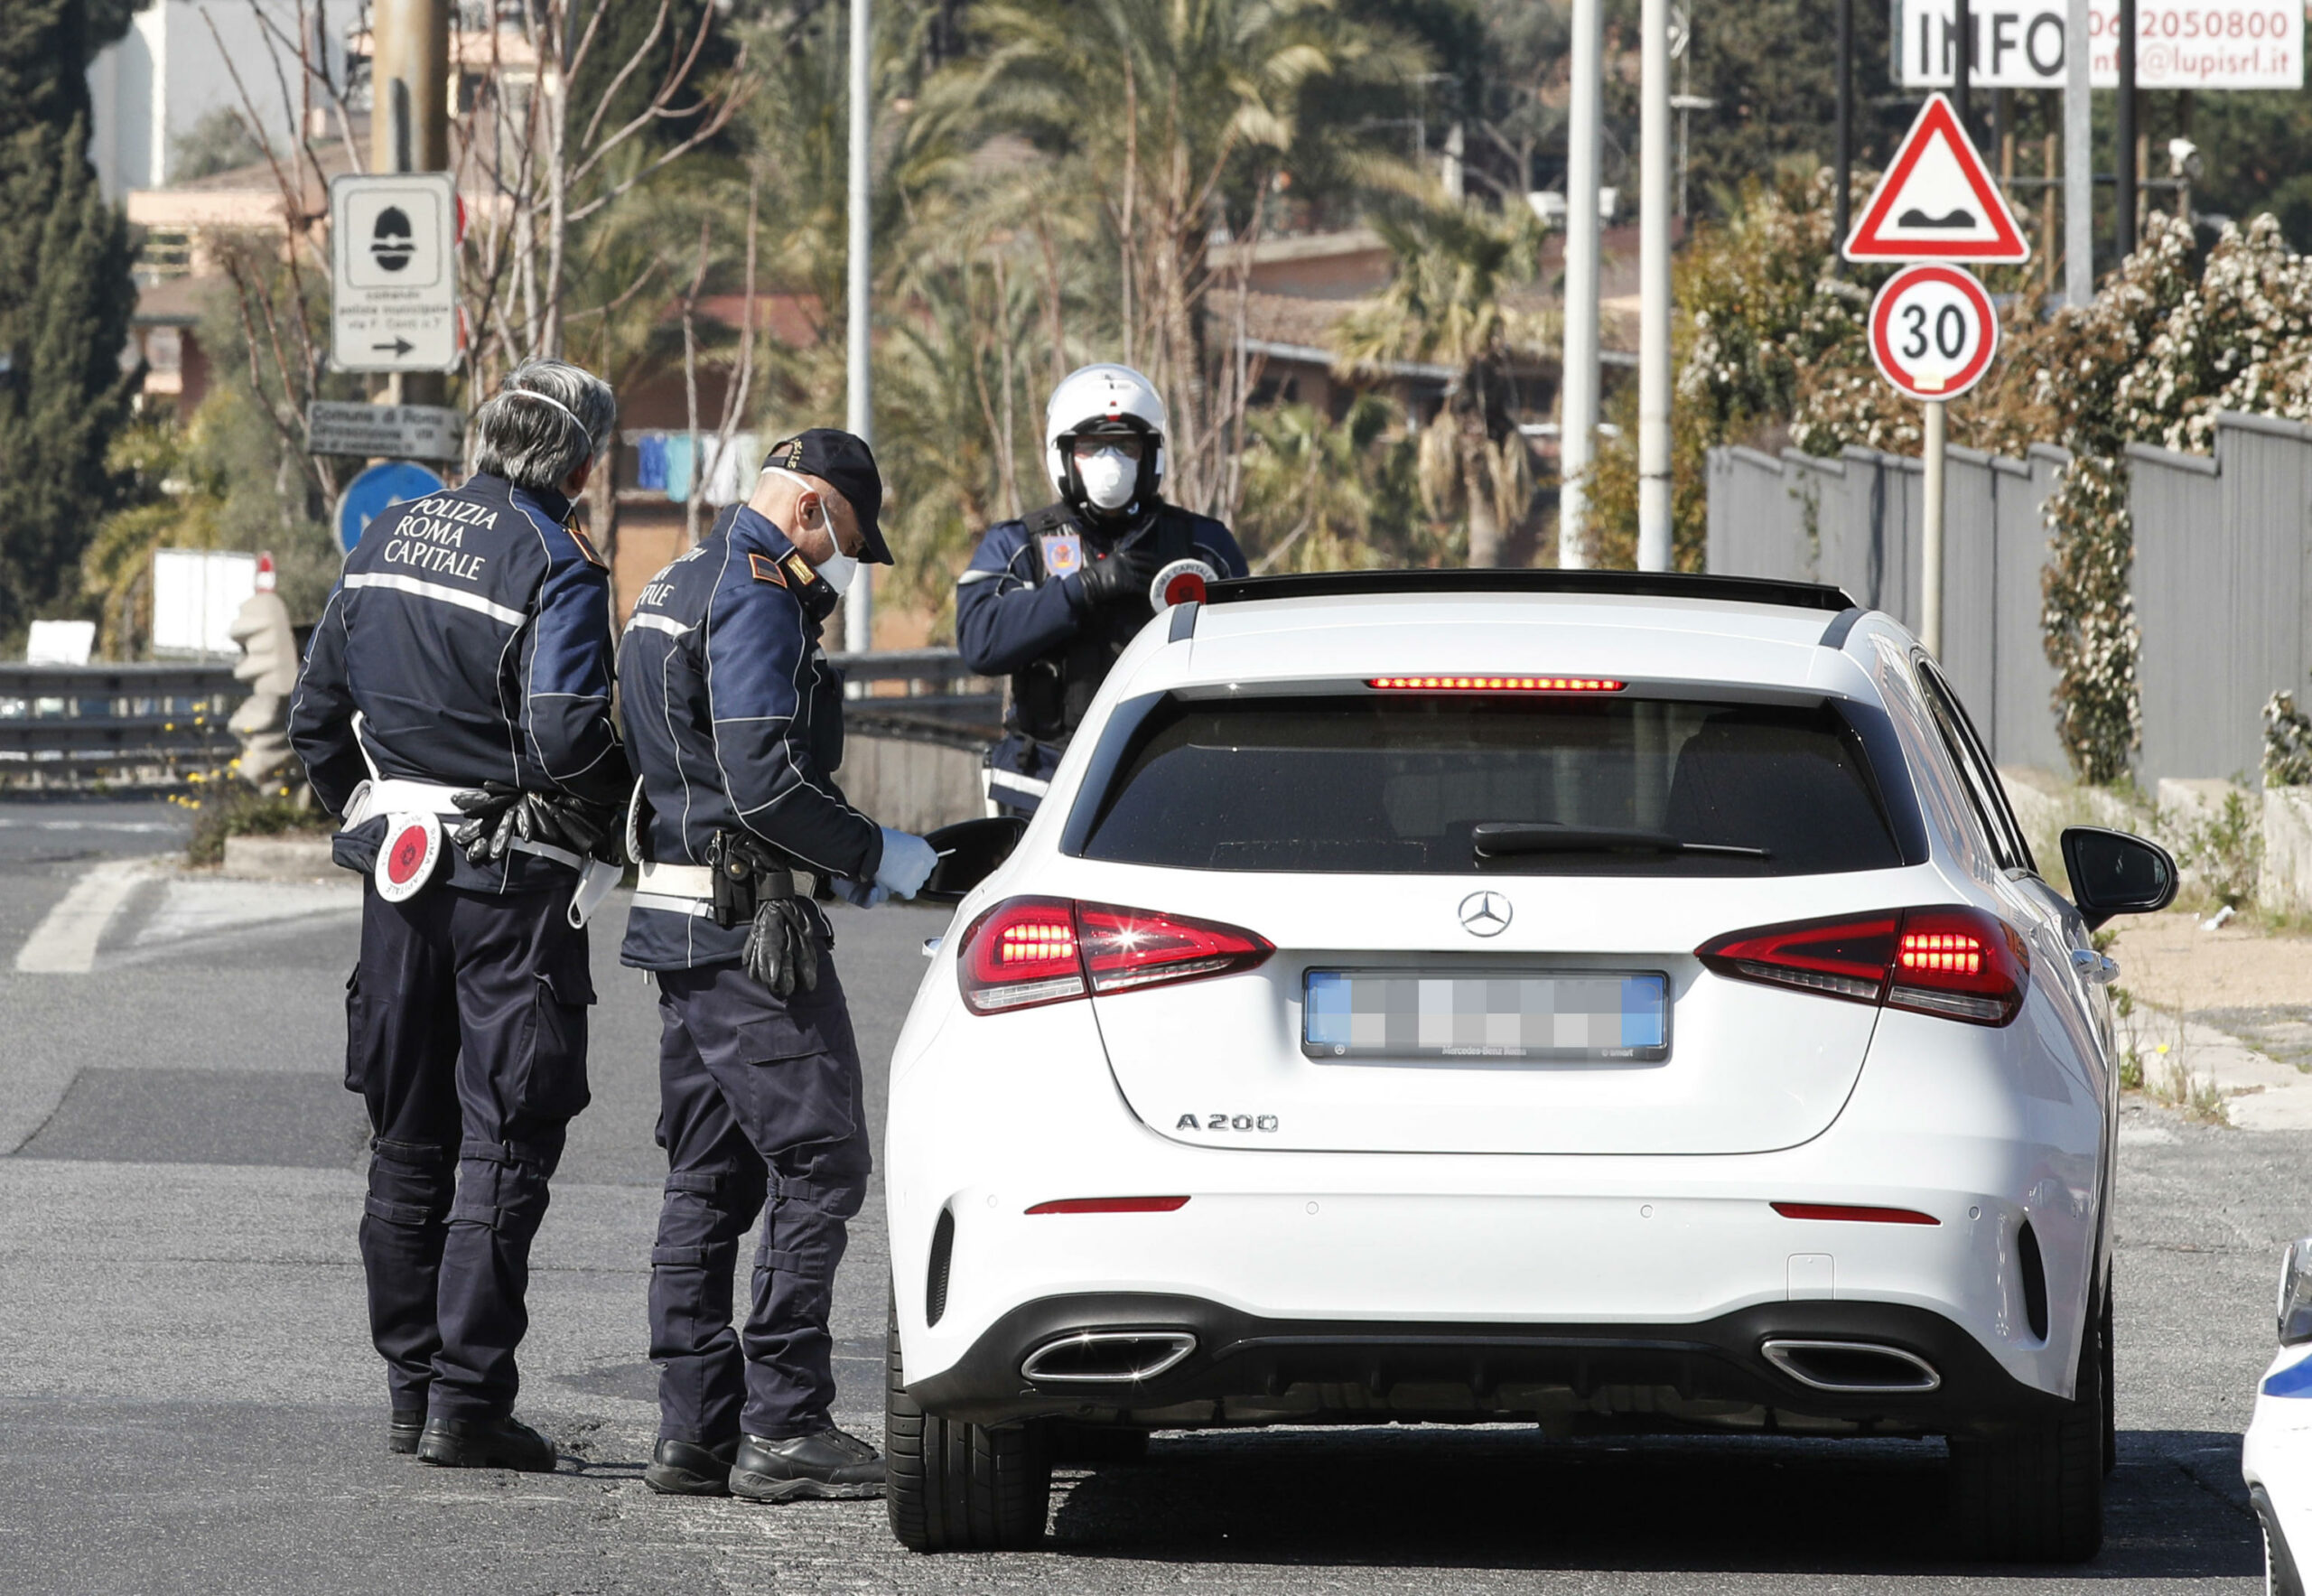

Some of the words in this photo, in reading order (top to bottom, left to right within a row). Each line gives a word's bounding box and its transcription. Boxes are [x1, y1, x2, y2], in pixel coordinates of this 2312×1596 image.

[2140, 11, 2289, 38] 2050800
[1920, 12, 2065, 77] INFO
[1902, 303, 1967, 359] 30
[409, 498, 499, 531] POLIZIA
[394, 515, 465, 548] ROMA
[384, 539, 486, 581] CAPITALE
[1441, 1045, 1503, 1056] Mercedes-Benz
[1176, 1114, 1201, 1132] A
[1207, 1114, 1279, 1133] 200
